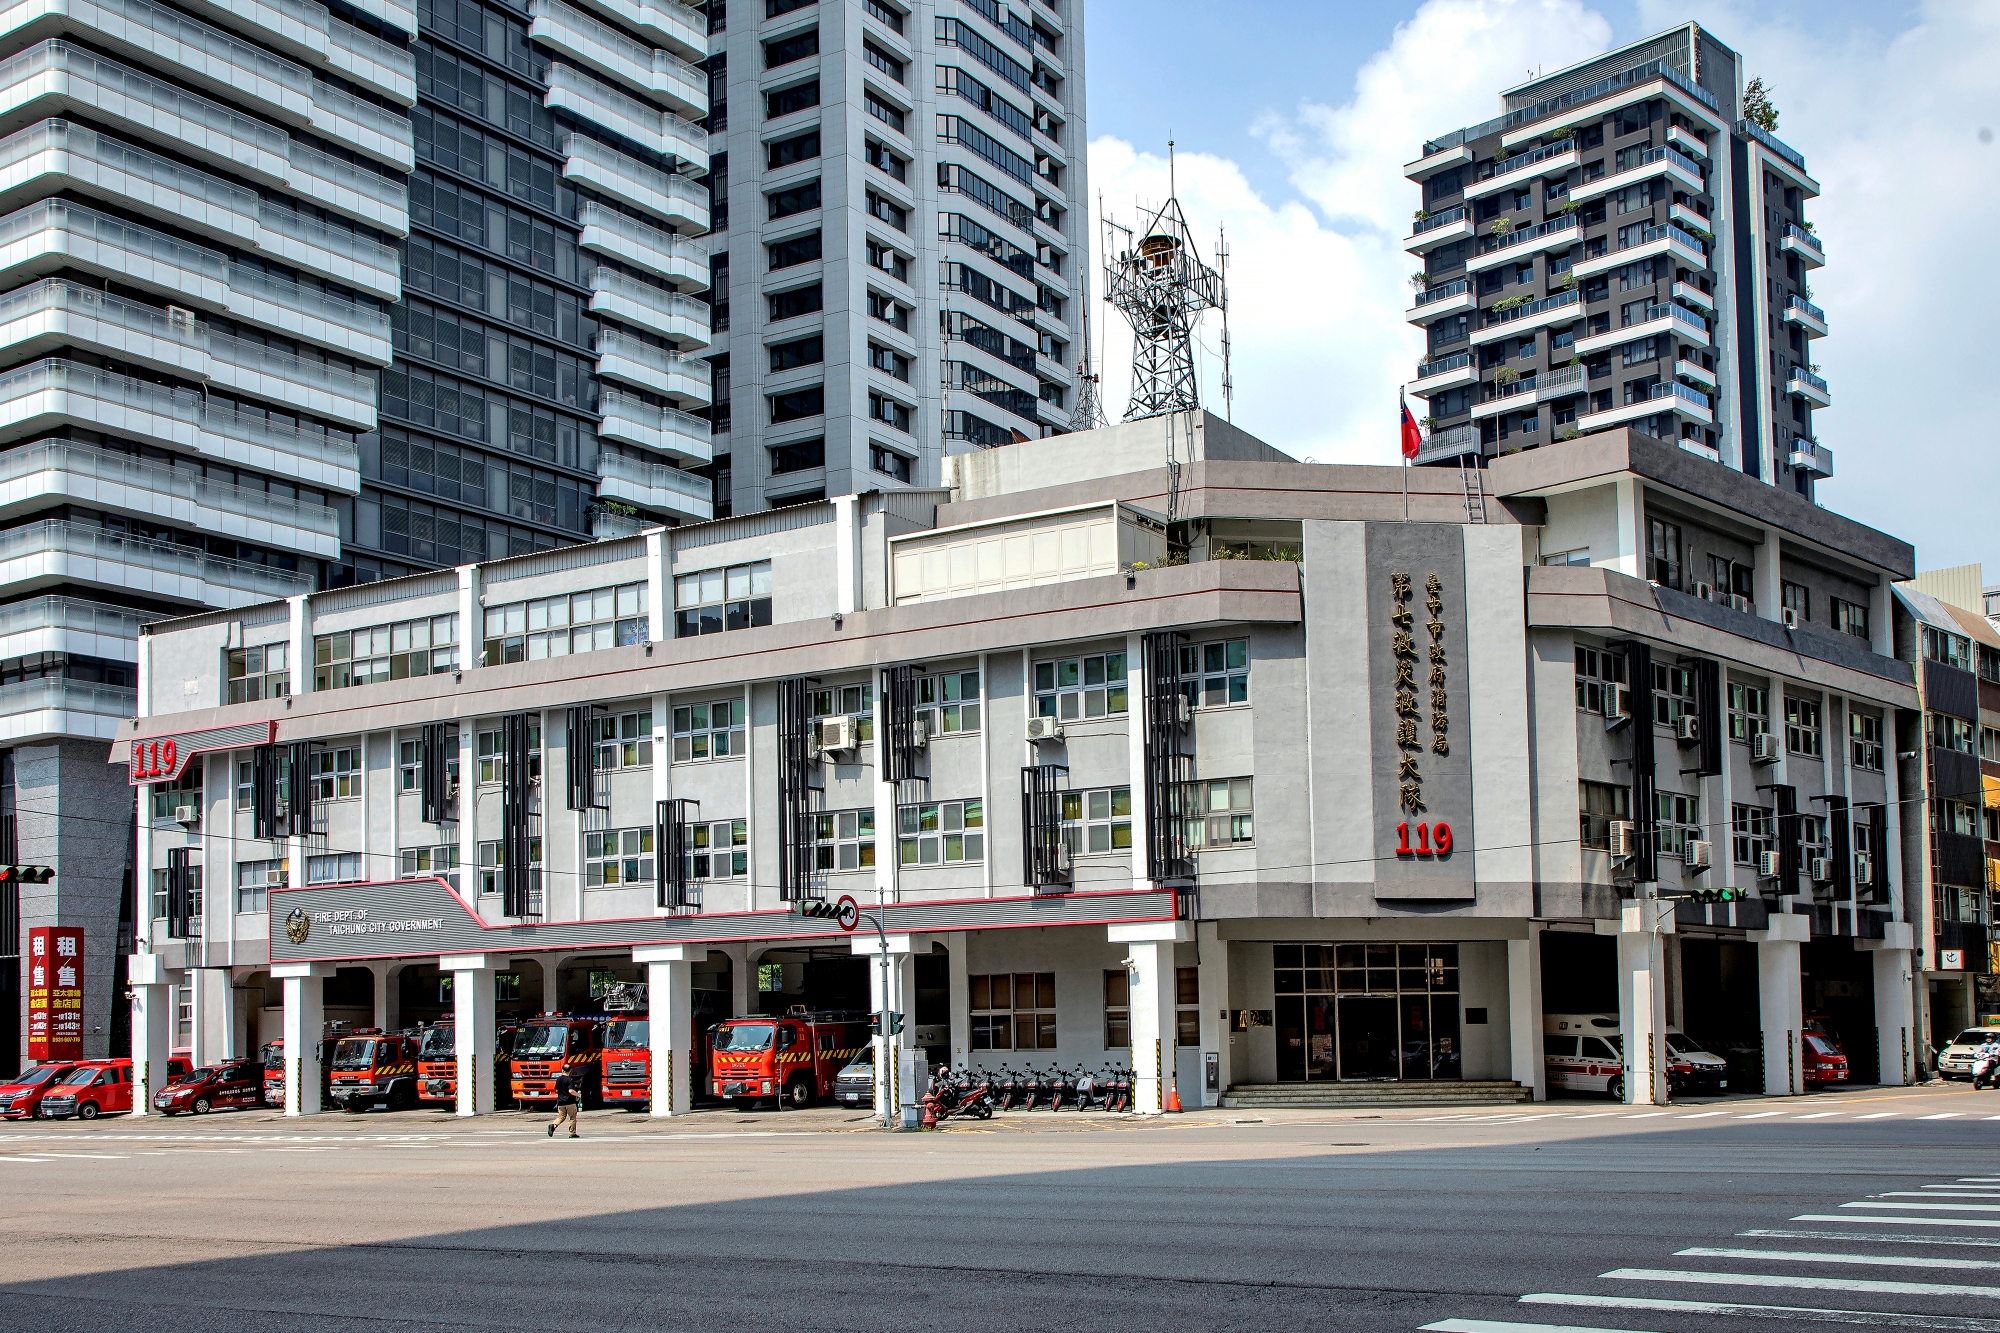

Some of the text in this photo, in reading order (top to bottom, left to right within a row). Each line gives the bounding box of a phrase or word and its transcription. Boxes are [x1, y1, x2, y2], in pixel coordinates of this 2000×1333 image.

[1425, 572, 1449, 752] 臺中市政府消防局
[1391, 572, 1425, 812] 第七救災救護大隊
[134, 739, 176, 778] 119
[1395, 821, 1453, 856] 119
[314, 910, 369, 923] FIRE DEPT. OF
[329, 918, 443, 935] TAICHUNG CITY GOVERNMENT
[53, 998, 81, 1009] 金店面
